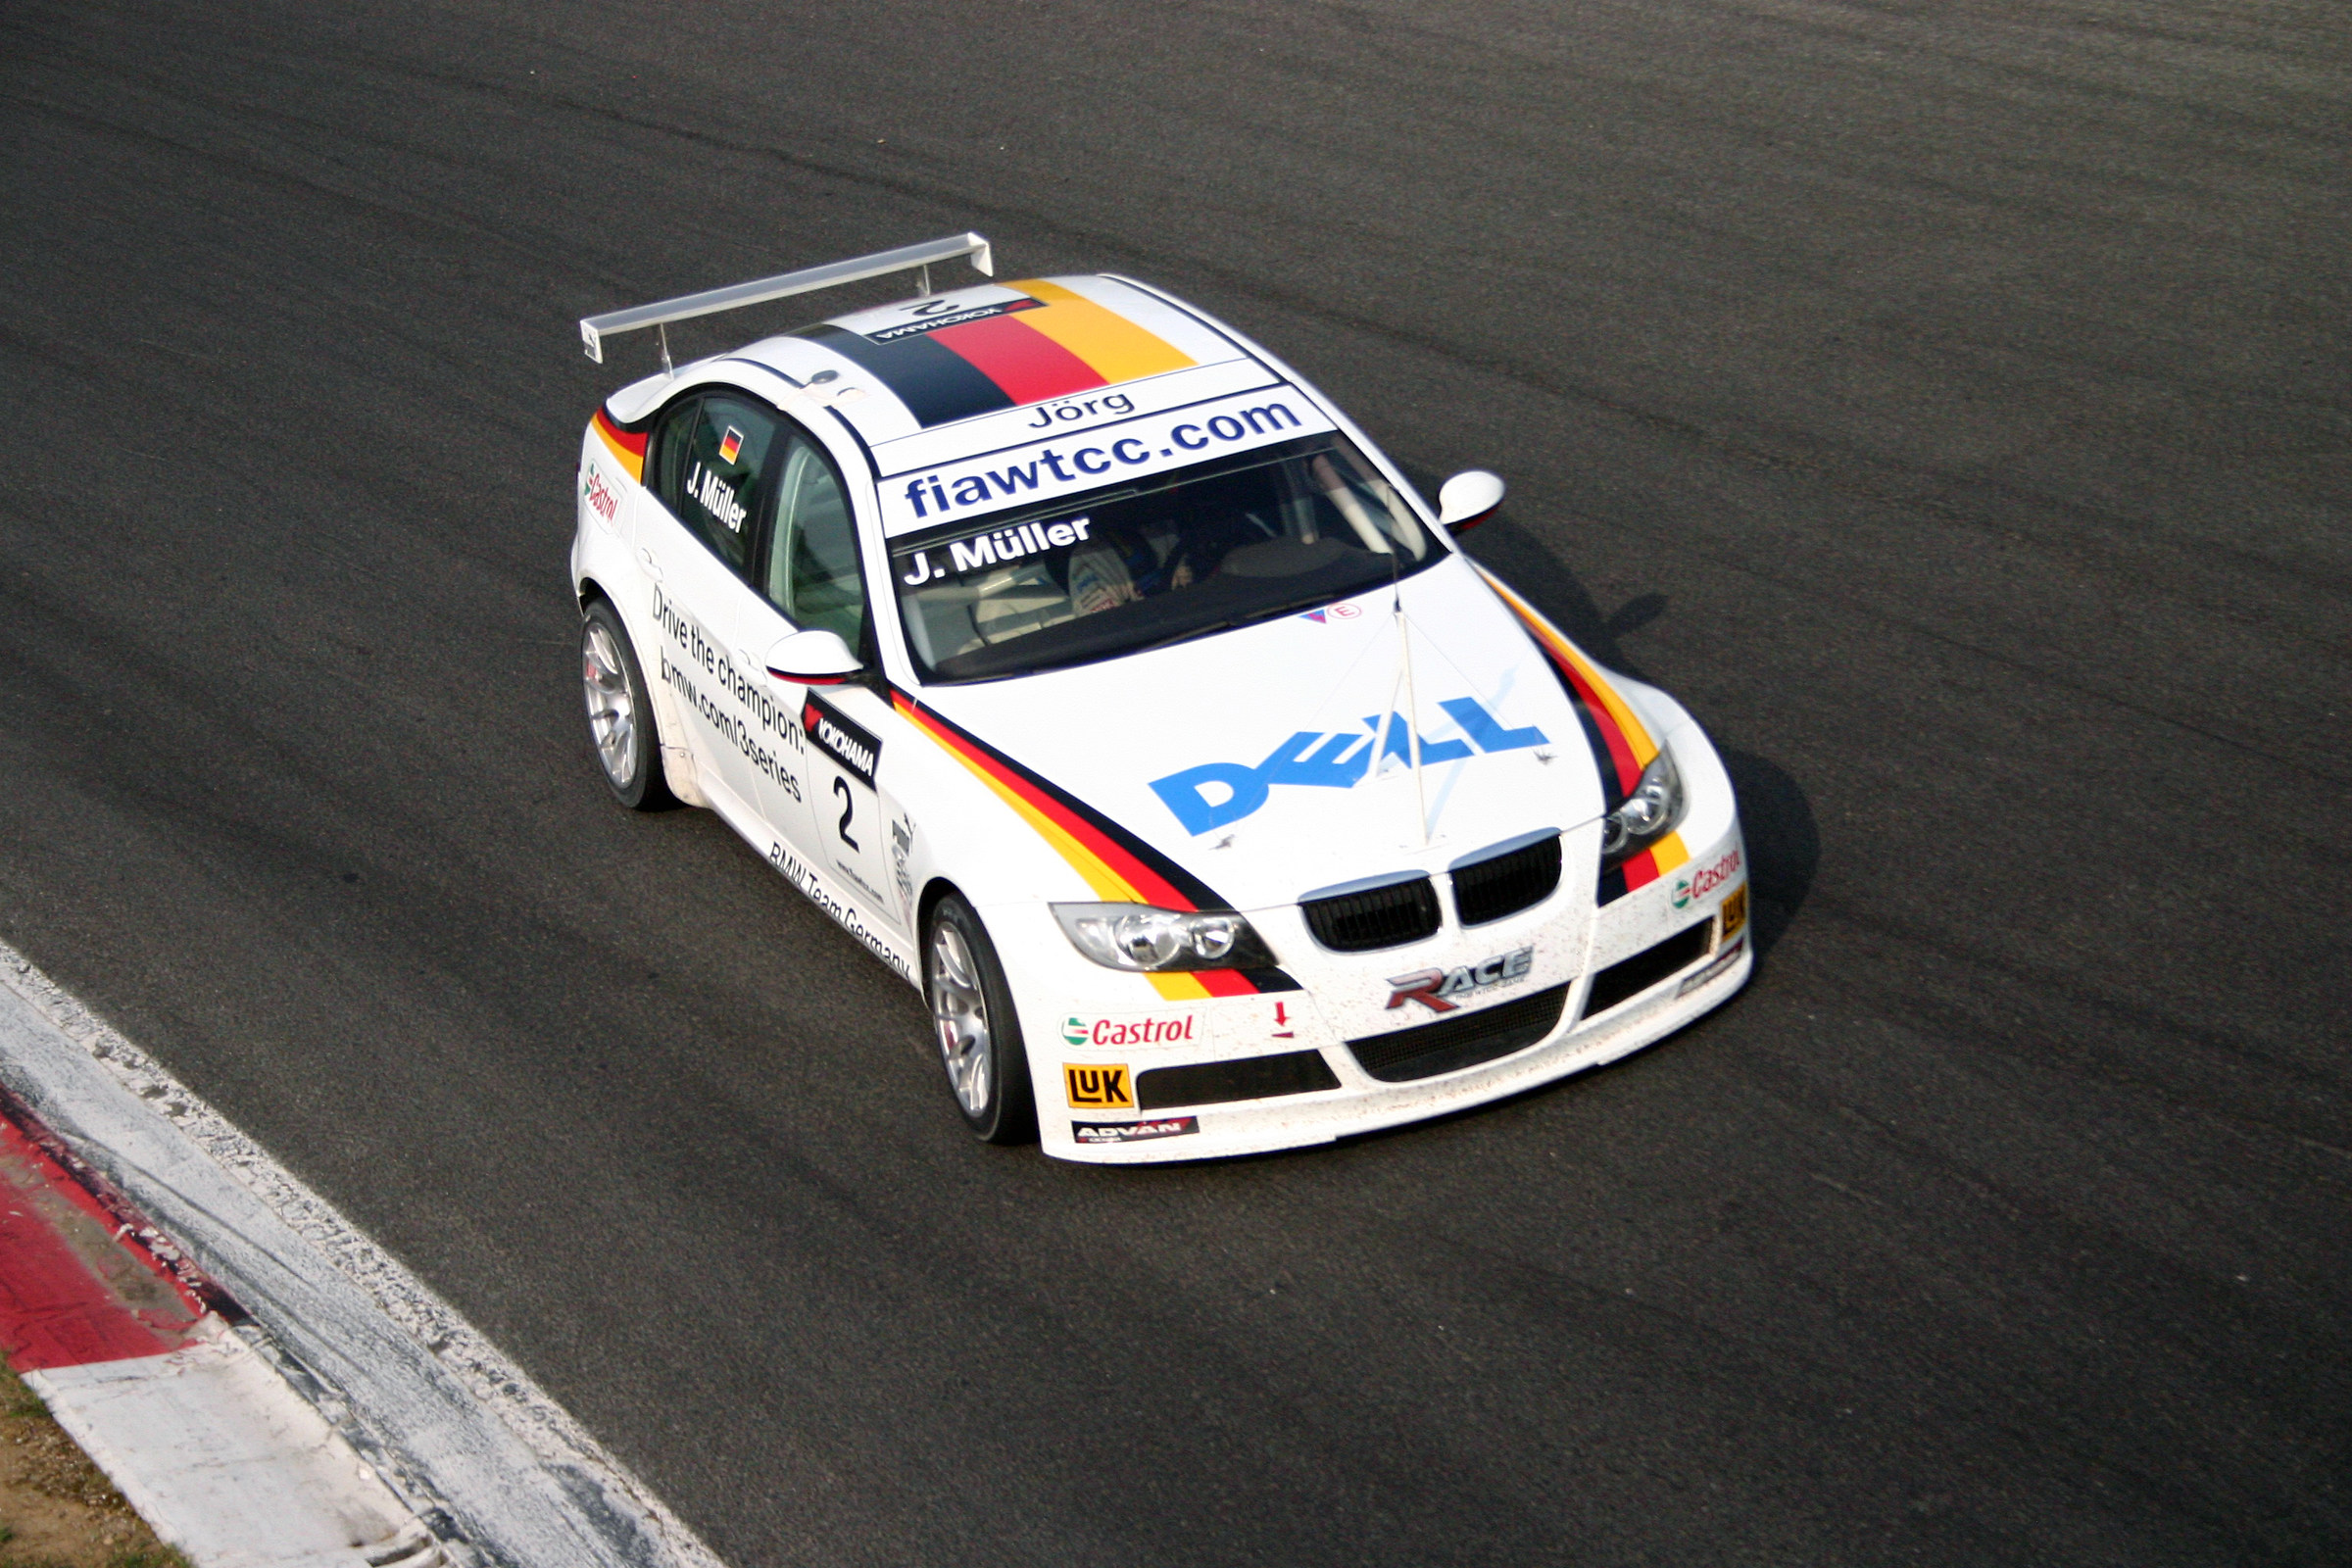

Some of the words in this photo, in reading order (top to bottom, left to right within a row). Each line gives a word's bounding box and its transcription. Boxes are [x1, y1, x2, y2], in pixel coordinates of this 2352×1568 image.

[876, 308, 1003, 340] YOKOHAMA
[899, 298, 960, 318] 2
[1027, 393, 1136, 429] Jörg
[904, 402, 1304, 518] fiawtcc.com
[686, 462, 702, 499] J.
[699, 469, 748, 534] Müller
[903, 551, 947, 586] J.
[949, 514, 1093, 573] Müller
[652, 582, 687, 649] Drive
[691, 626, 715, 675] the
[717, 655, 805, 756] champion:
[817, 717, 875, 778] YOKOHAMA
[1147, 696, 1551, 837] DELL
[833, 775, 860, 854] 2
[1691, 849, 1741, 899] Castrol
[769, 841, 808, 887] BMW
[808, 871, 843, 920] Team
[844, 907, 911, 980] Germany
[1384, 945, 1535, 1013] RACE
[1091, 1014, 1195, 1047] Castrol
[1067, 1069, 1130, 1103] LUK
[1077, 1121, 1182, 1138] ADVAN
